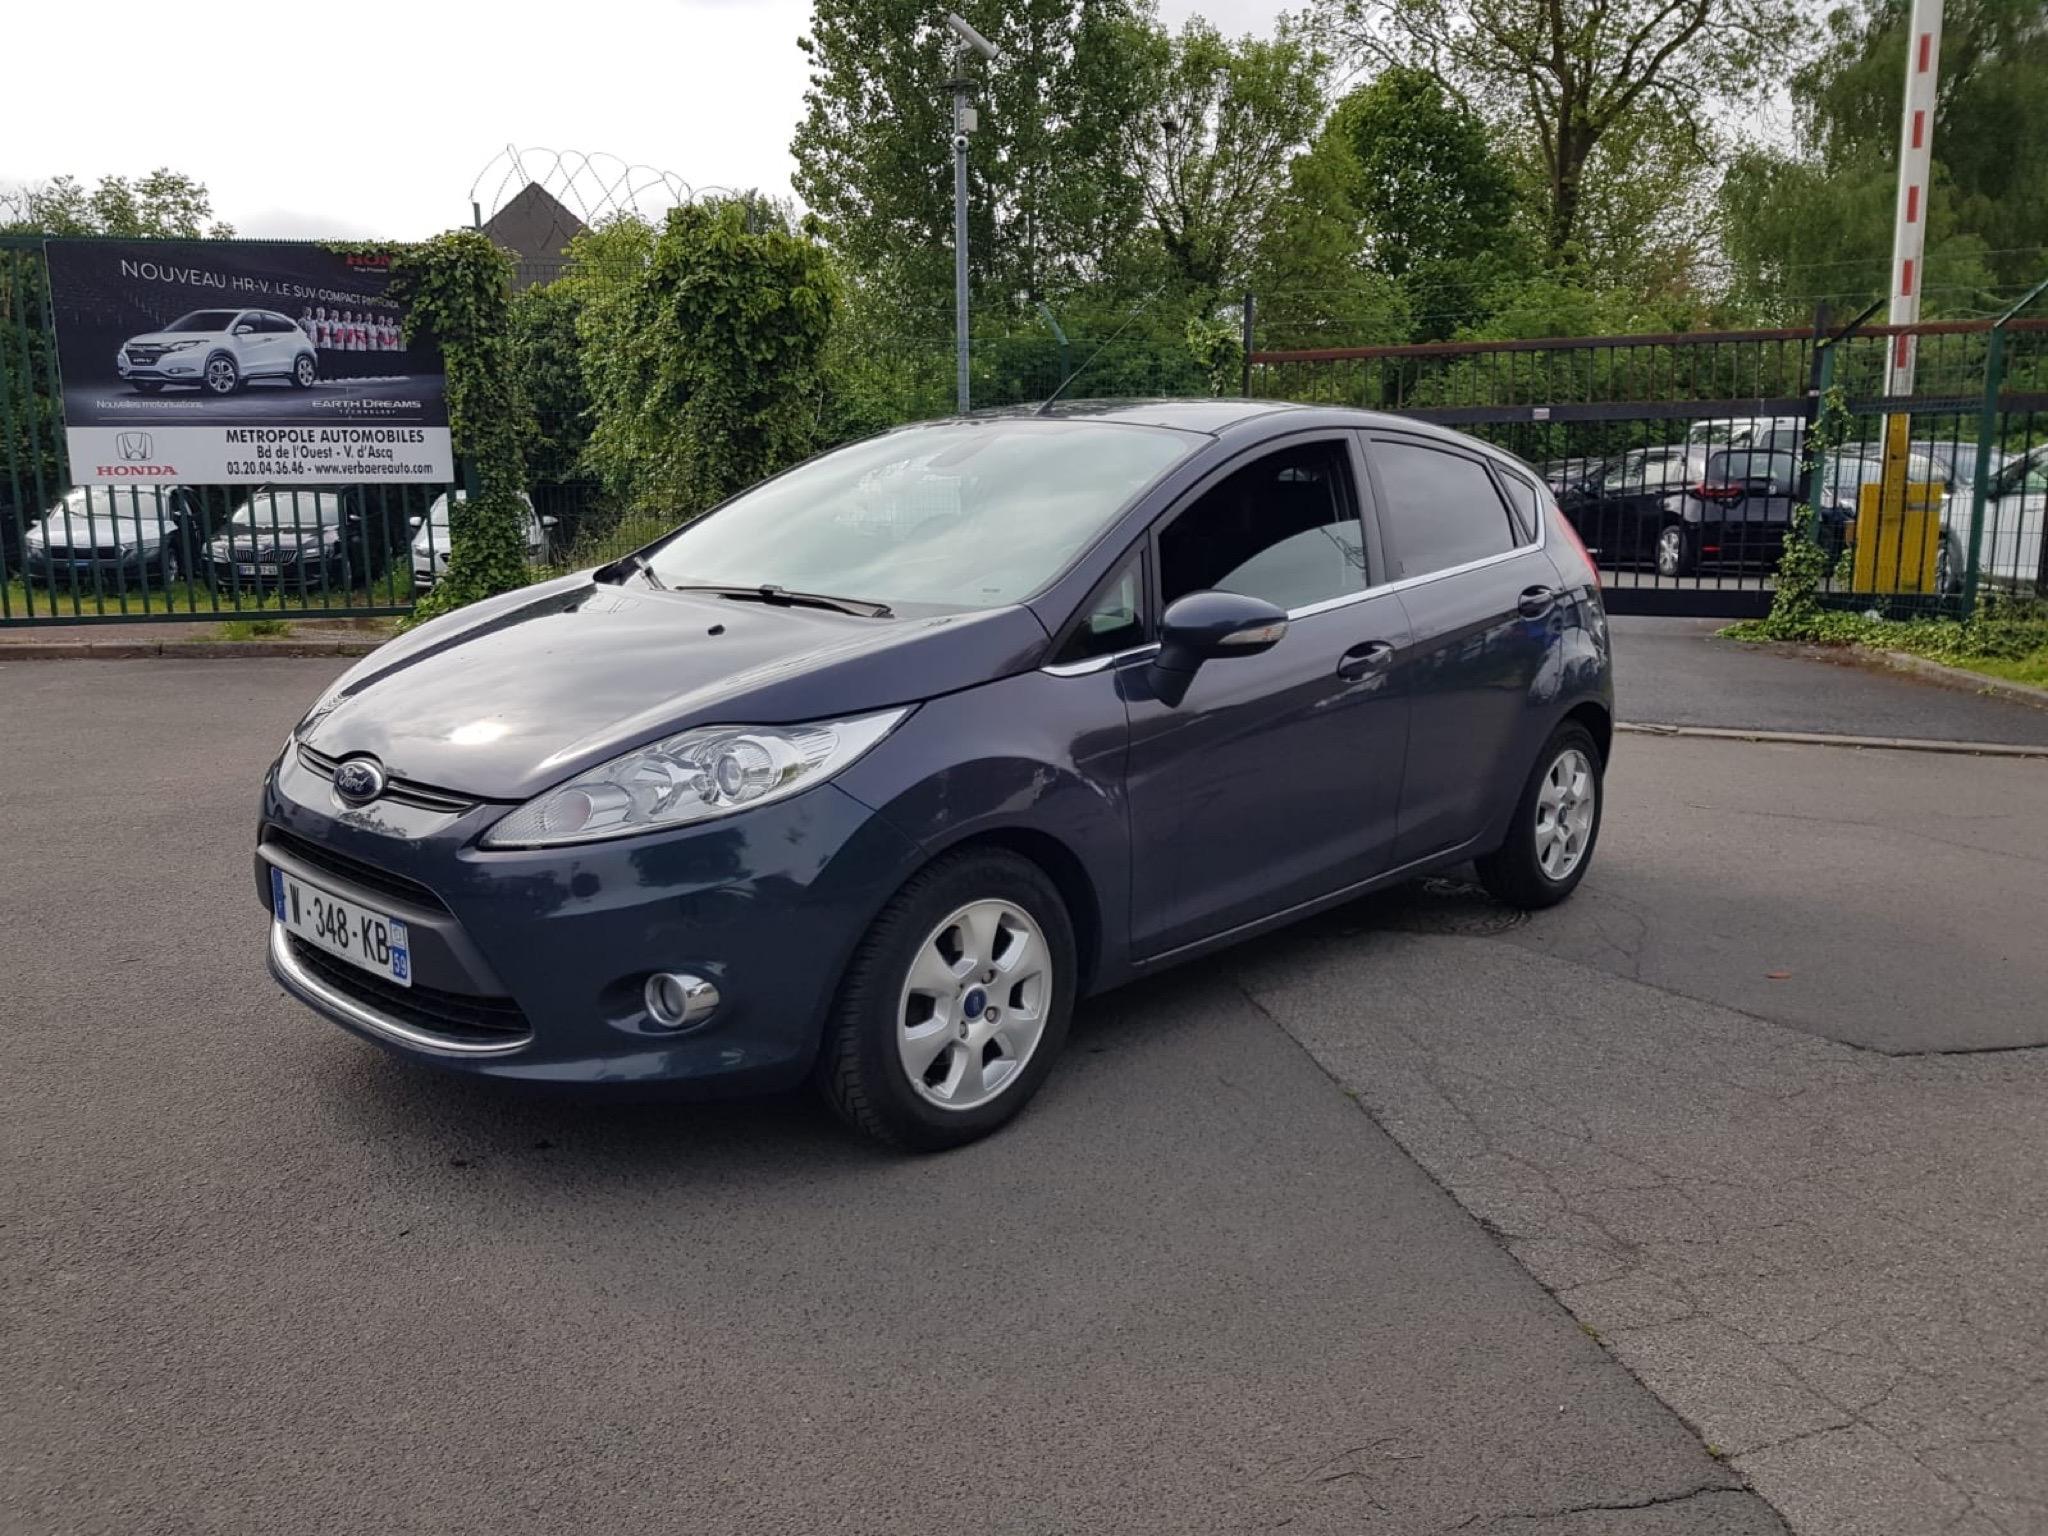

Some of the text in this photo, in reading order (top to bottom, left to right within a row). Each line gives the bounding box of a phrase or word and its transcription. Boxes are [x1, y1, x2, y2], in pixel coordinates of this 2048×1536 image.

[121, 259, 226, 288] NOUVEAU
[276, 281, 290, 296] LE
[293, 285, 316, 299] SUV
[319, 288, 361, 305] COMPACT
[311, 399, 422, 408] EARTH DREAMS
[225, 429, 425, 444] METROPOLE AUTOMOBILES
[256, 445, 272, 459] Bd
[275, 446, 290, 459] de
[292, 445, 333, 459] l'Ouest
[357, 445, 394, 461] d'Ascq
[96, 466, 178, 476] HONDA
[226, 461, 304, 475] 03.20.04.36.46
[314, 461, 433, 475] www.verbaereauto.com
[338, 766, 369, 791] Ford
[394, 951, 408, 976] 59
